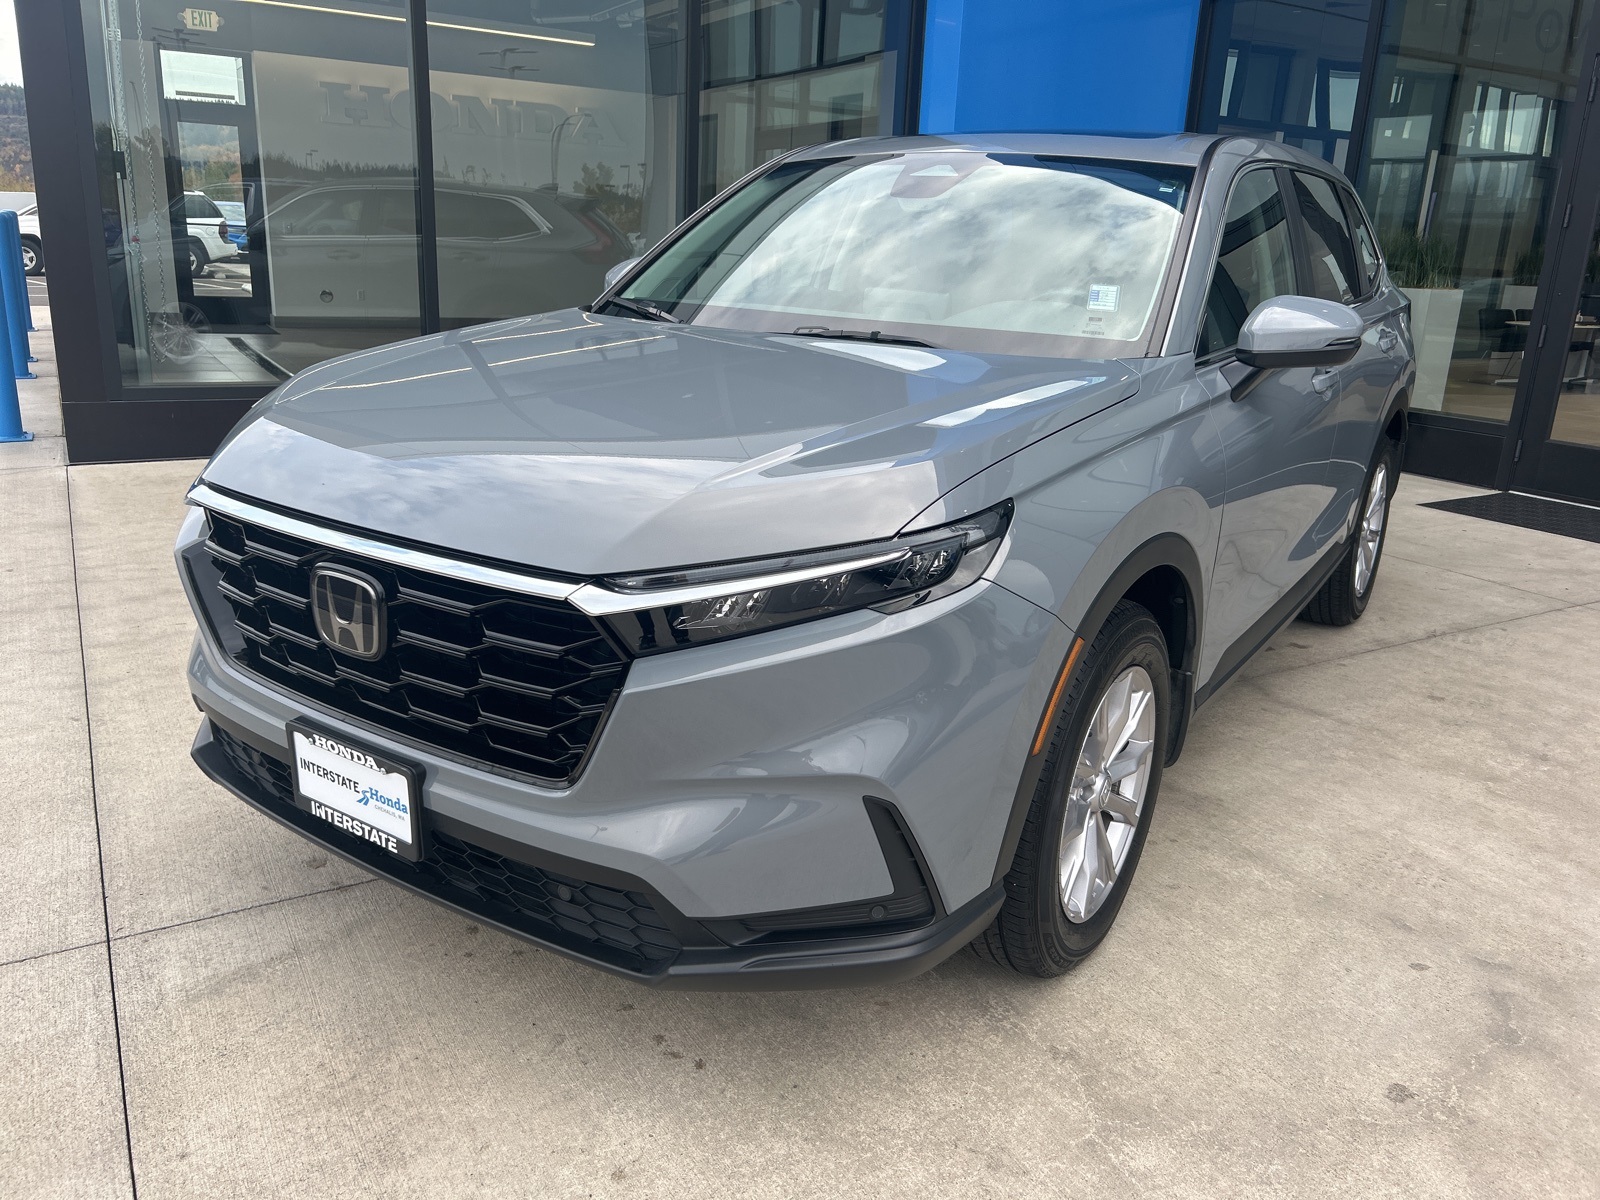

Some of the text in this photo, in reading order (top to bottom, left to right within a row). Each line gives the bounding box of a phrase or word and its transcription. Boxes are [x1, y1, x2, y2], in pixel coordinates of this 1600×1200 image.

[190, 10, 212, 28] EXIT
[317, 80, 630, 148] HONDA
[312, 733, 382, 773] HONDA
[299, 757, 408, 815] INTERSTATE Honda
[310, 800, 398, 854] INTERSTATE
